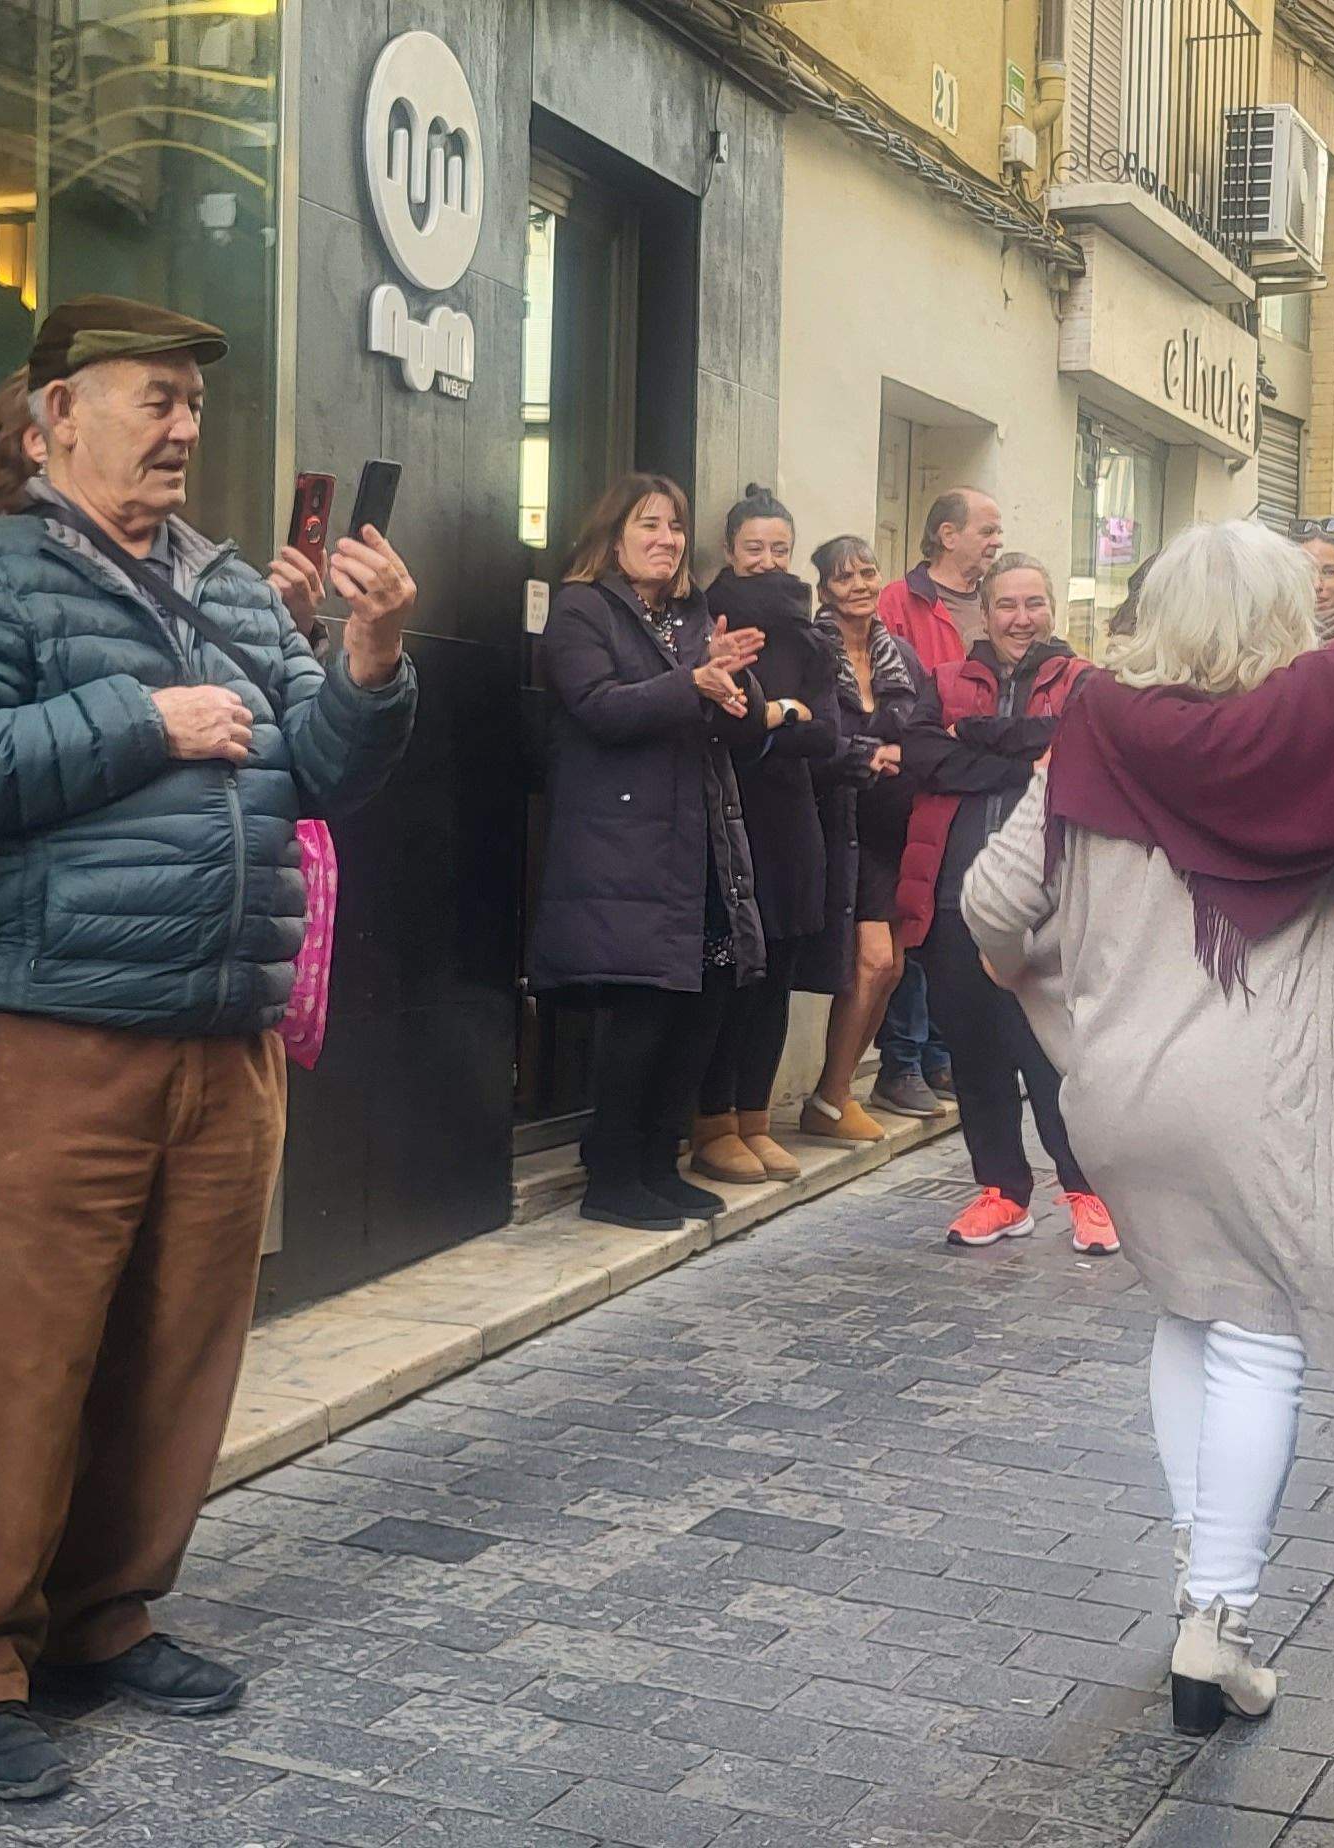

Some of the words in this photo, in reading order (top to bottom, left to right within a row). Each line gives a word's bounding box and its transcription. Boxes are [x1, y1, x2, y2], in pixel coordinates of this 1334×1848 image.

[934, 69, 954, 130] 21
[437, 374, 471, 401] wear
[1163, 328, 1253, 443] elhula
